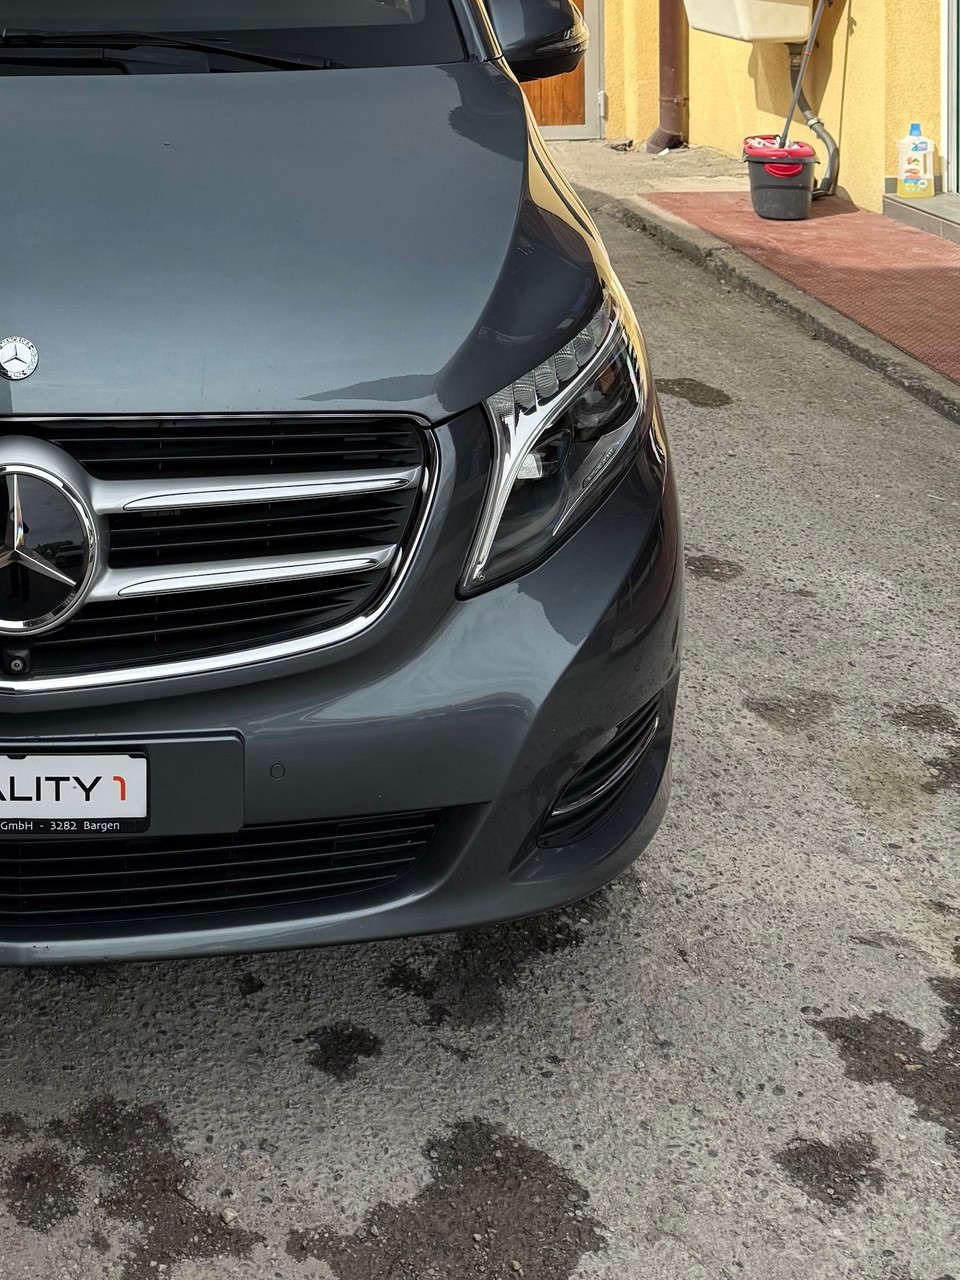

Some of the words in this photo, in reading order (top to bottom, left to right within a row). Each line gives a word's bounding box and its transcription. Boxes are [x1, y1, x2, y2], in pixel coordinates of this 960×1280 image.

[0, 821, 34, 831] GmbH
[50, 821, 77, 831] 3282
[83, 821, 120, 832] Bargen
